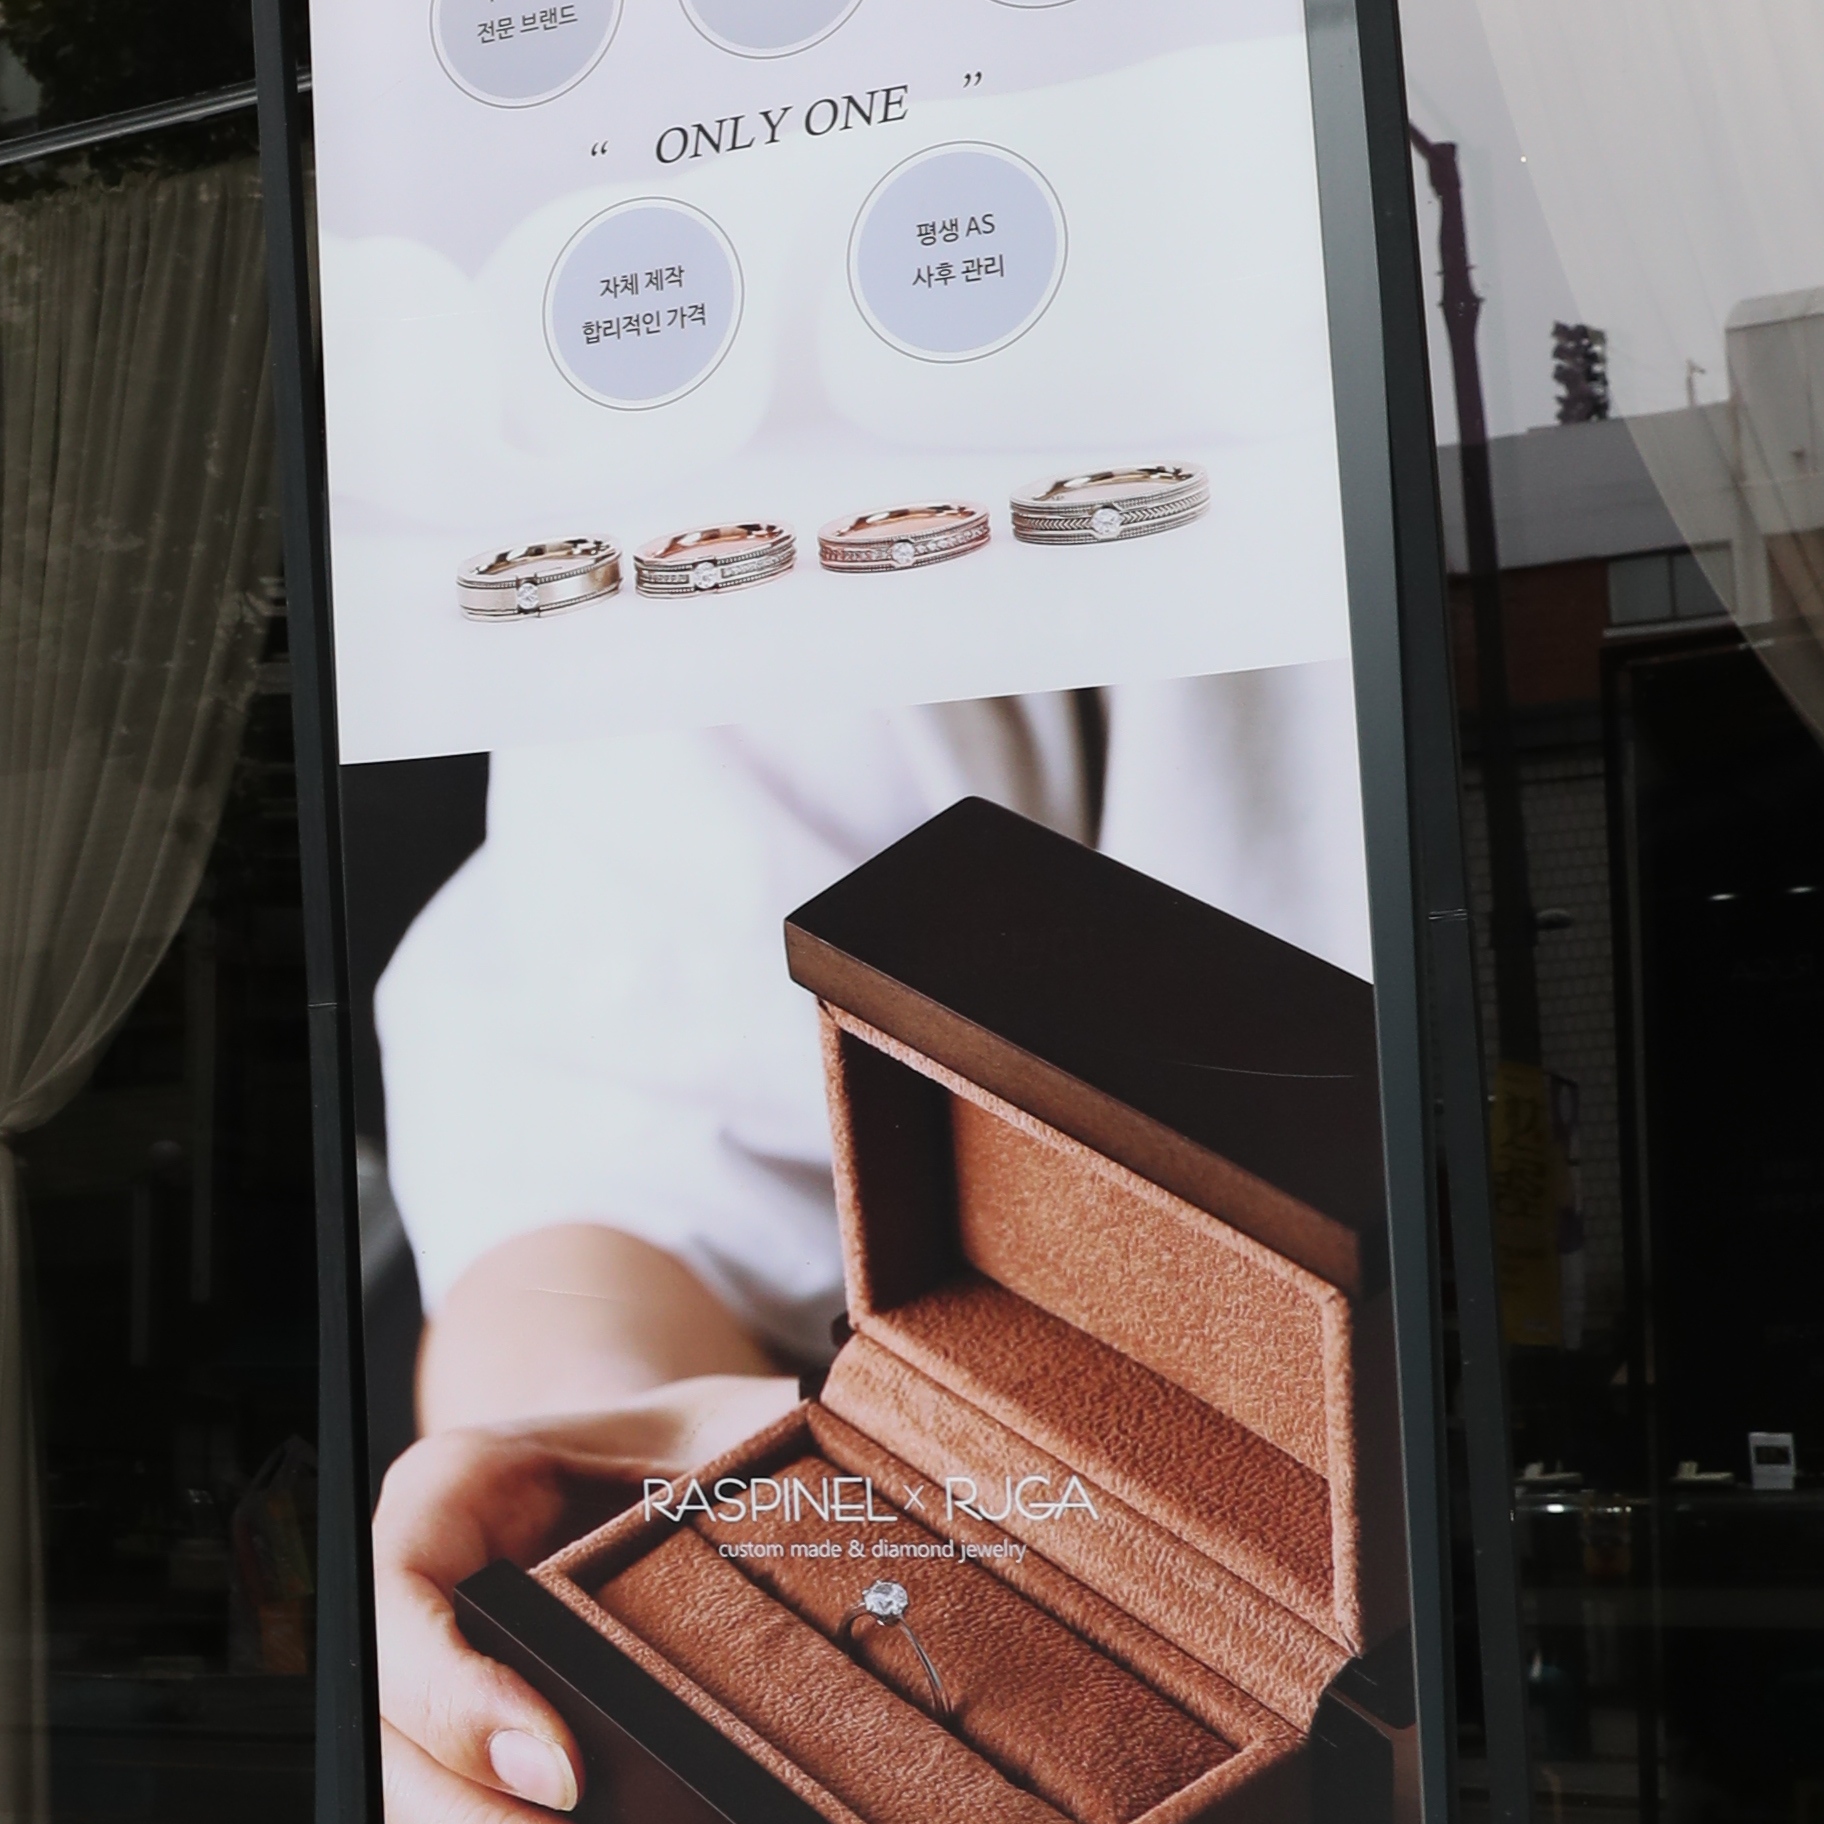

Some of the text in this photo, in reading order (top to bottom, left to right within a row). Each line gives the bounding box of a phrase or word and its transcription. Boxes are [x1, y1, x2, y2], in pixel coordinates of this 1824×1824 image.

[478, 5, 578, 43] 전문 브랜드
[656, 106, 793, 163] ONLY
[805, 85, 908, 136] ONE
[916, 214, 995, 246] 평생 AS
[600, 265, 685, 298] 자체 제작
[912, 254, 1004, 288] 사후 관리
[582, 303, 706, 344] 합리적인 가격
[643, 1476, 899, 1523] RASPINEL
[718, 1538, 1028, 1564] custom made & diamond jewelry
